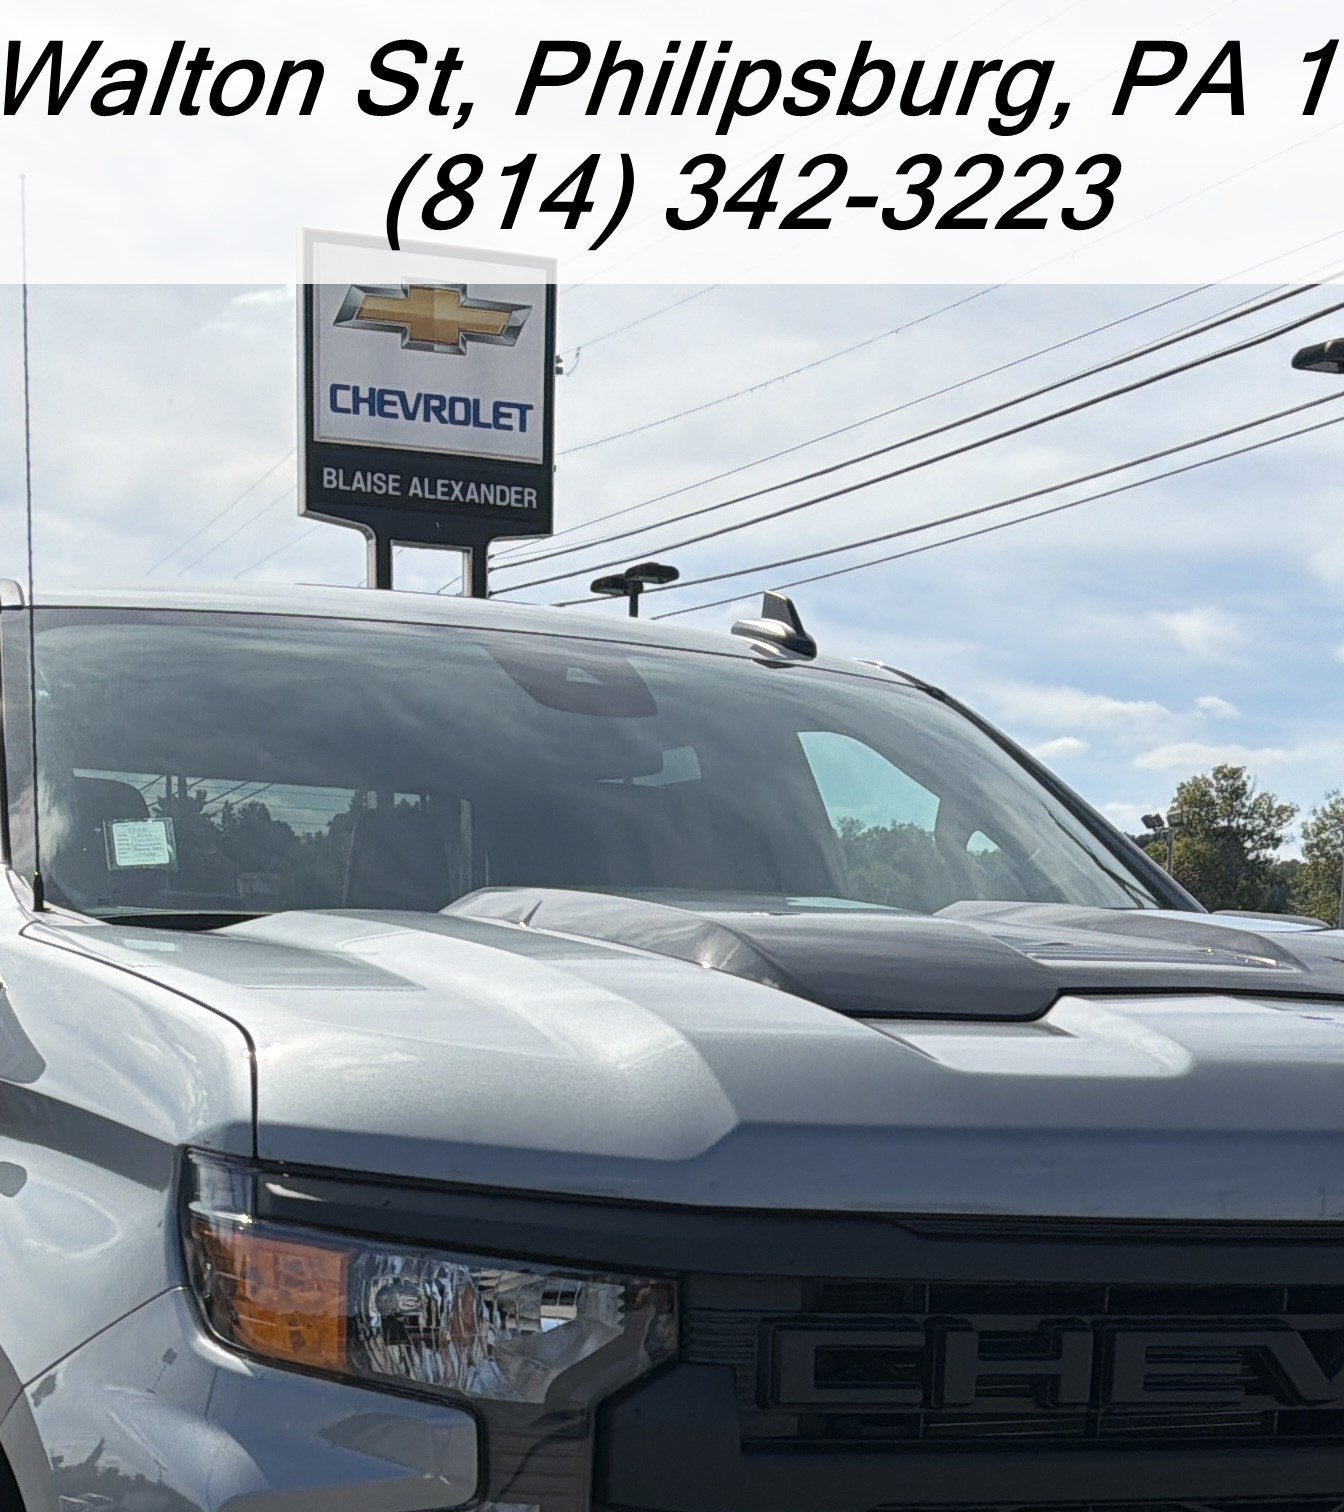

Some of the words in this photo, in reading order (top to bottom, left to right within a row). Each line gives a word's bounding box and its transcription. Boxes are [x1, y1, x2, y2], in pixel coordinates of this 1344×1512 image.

[329, 382, 534, 433] CHEVROLET
[322, 466, 402, 497] BLAISE
[408, 475, 538, 509] ALEXANDER
